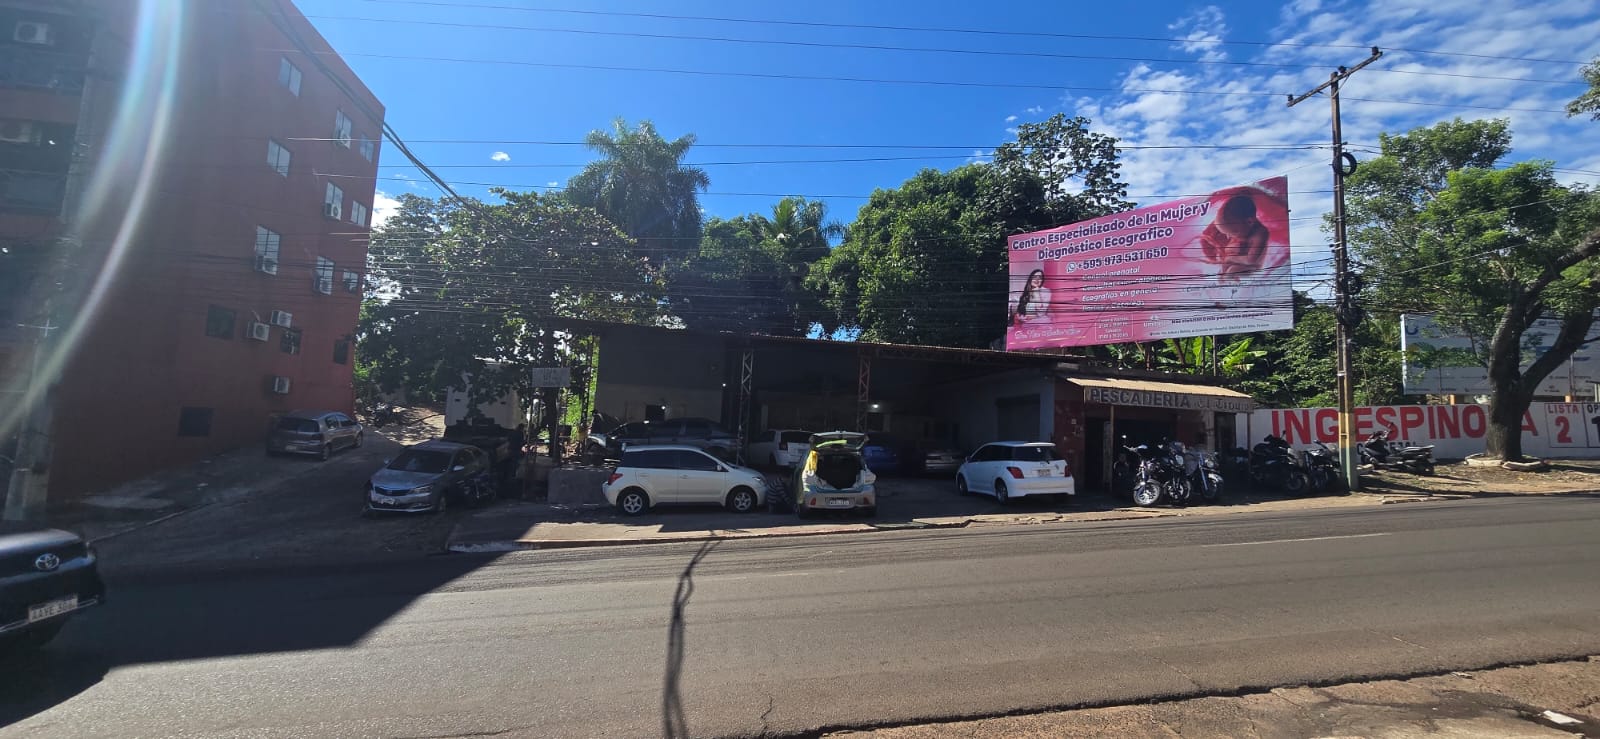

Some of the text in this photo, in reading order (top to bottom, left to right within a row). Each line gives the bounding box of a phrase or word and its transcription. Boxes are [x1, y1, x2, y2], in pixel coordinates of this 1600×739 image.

[1012, 202, 1210, 250] Centro Especializado de la Mujer y
[1038, 239, 1102, 261] Diagnóstico
[1078, 247, 1168, 270] +595 973 531 650
[1120, 289, 1129, 297] en
[1090, 388, 1191, 408] PESCADERIA
[1548, 404, 1579, 414] LISTA
[1354, 405, 1538, 443] ESPINOA
[1555, 415, 1573, 444] 2
